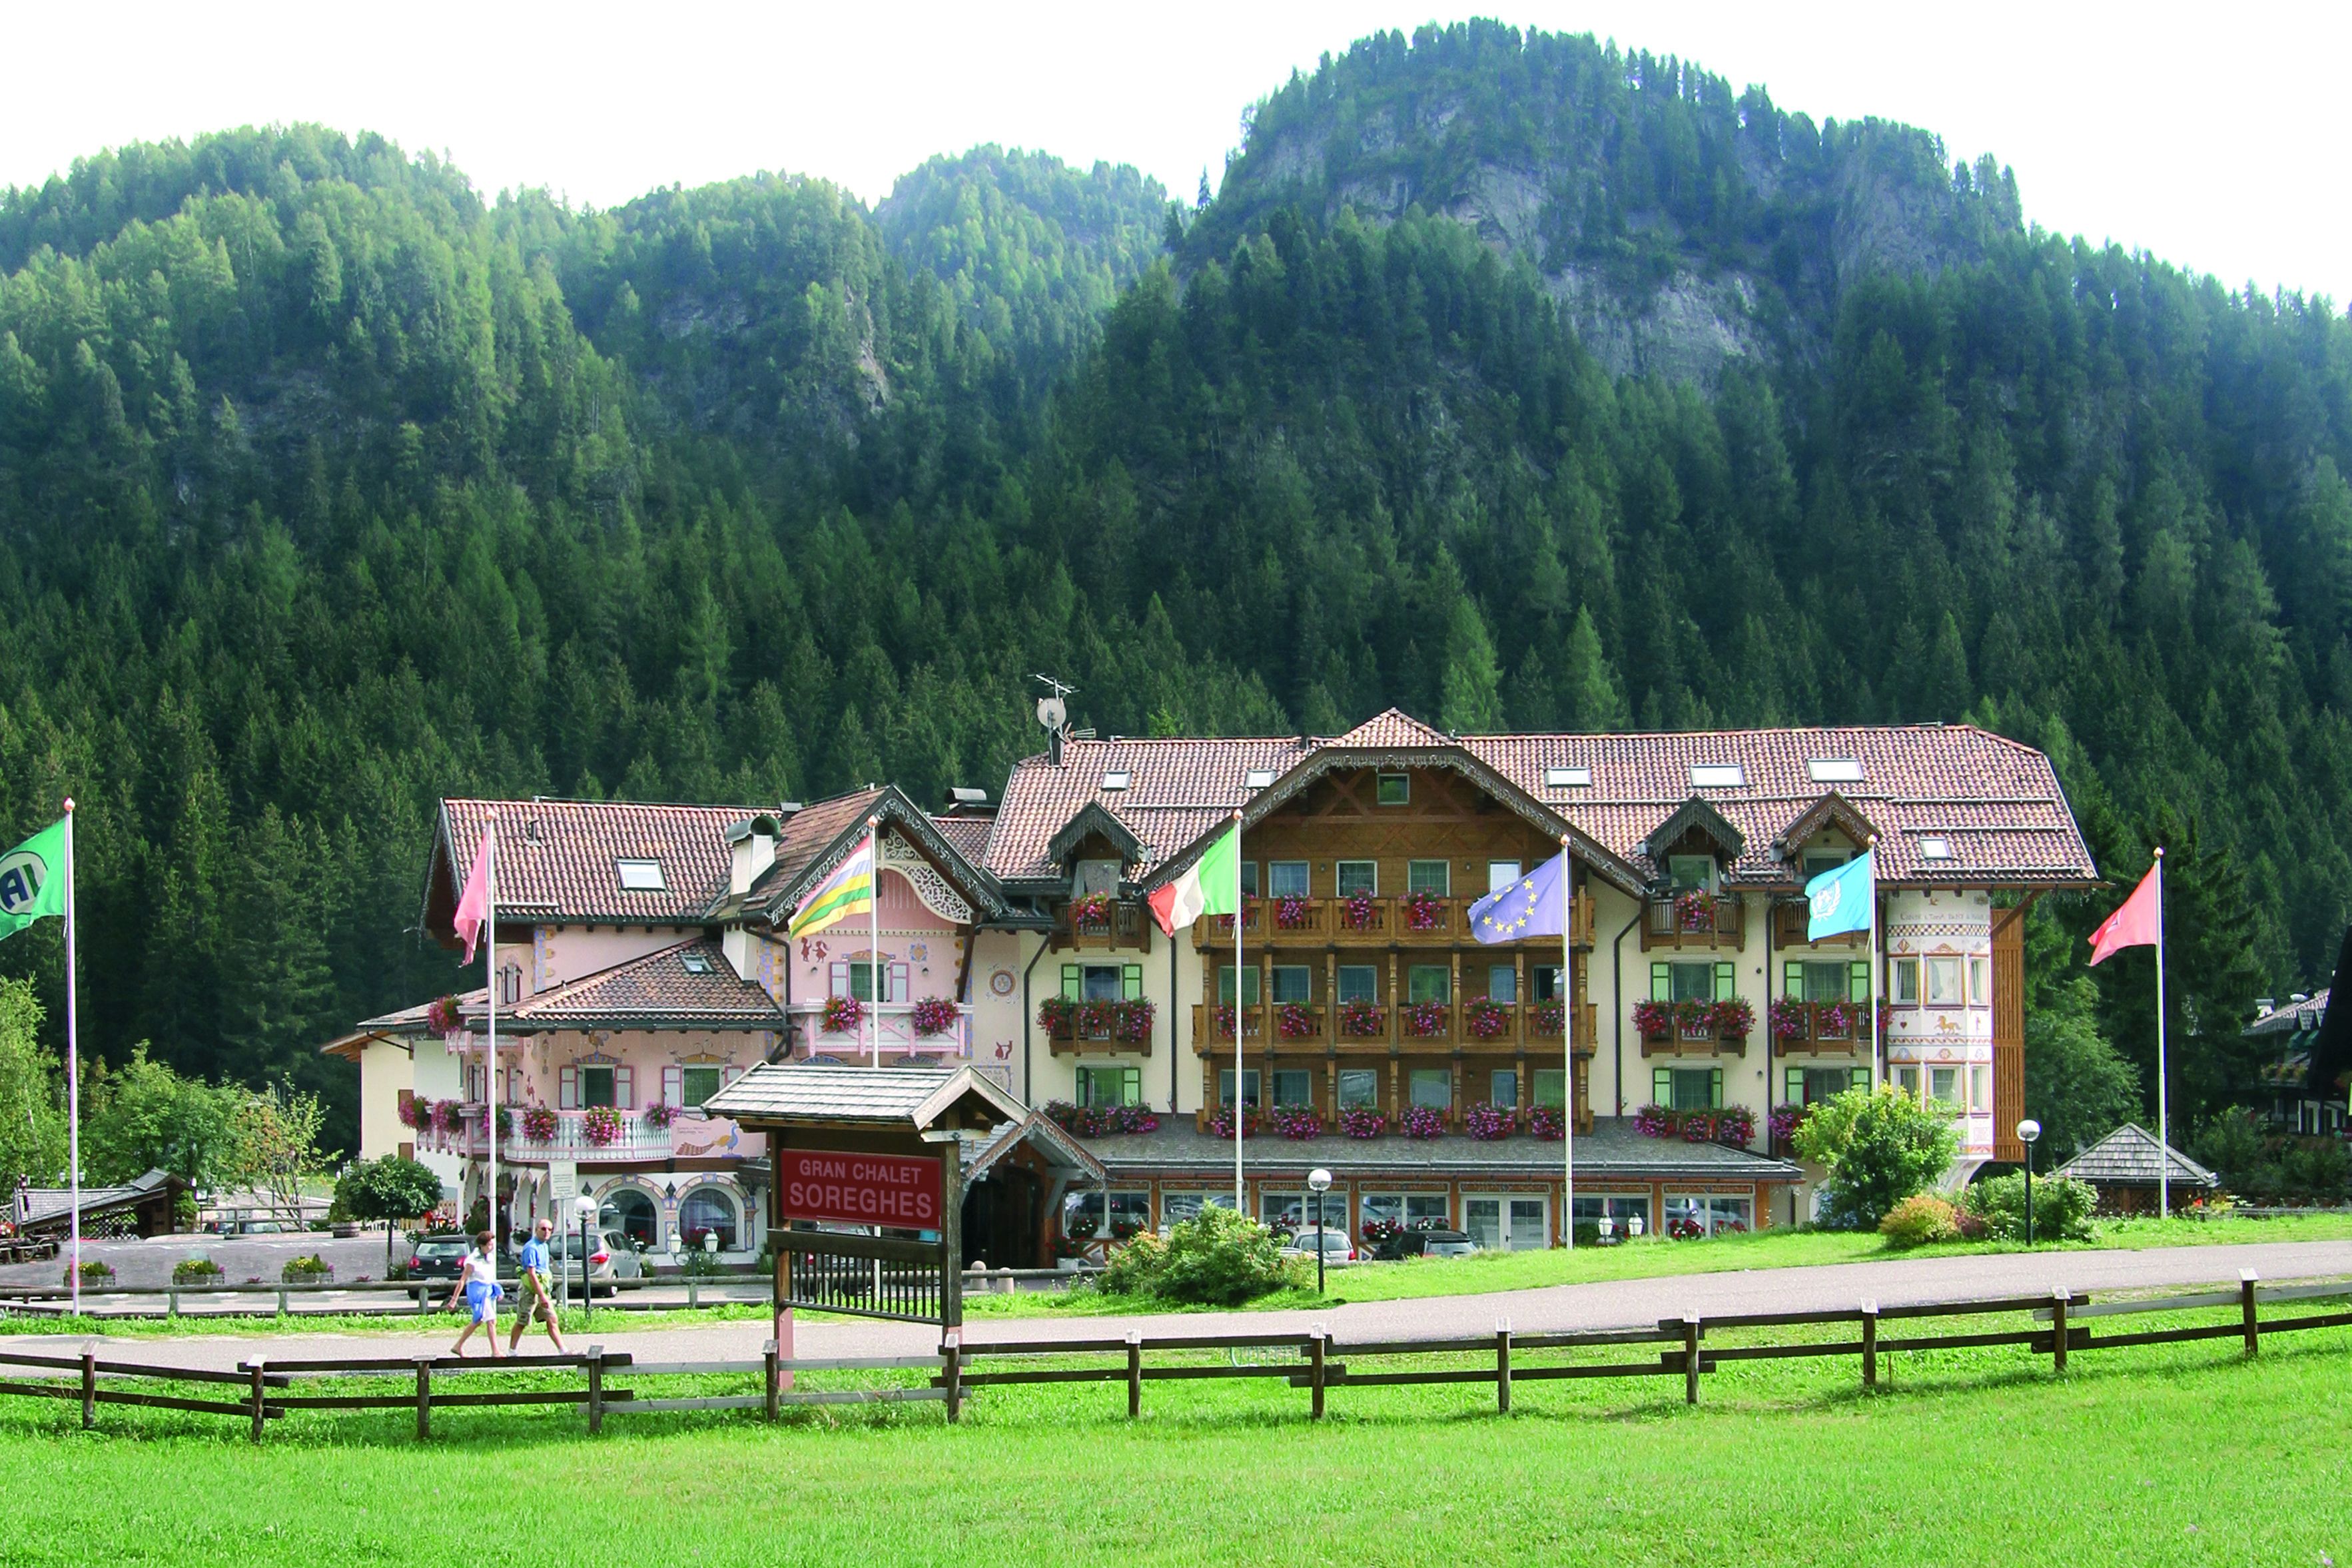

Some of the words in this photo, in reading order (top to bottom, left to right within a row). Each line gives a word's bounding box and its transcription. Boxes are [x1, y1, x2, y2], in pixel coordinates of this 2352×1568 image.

[799, 1159, 845, 1178] GRAN
[853, 1163, 922, 1184] CHALET
[789, 1182, 932, 1218] SOREGHES
